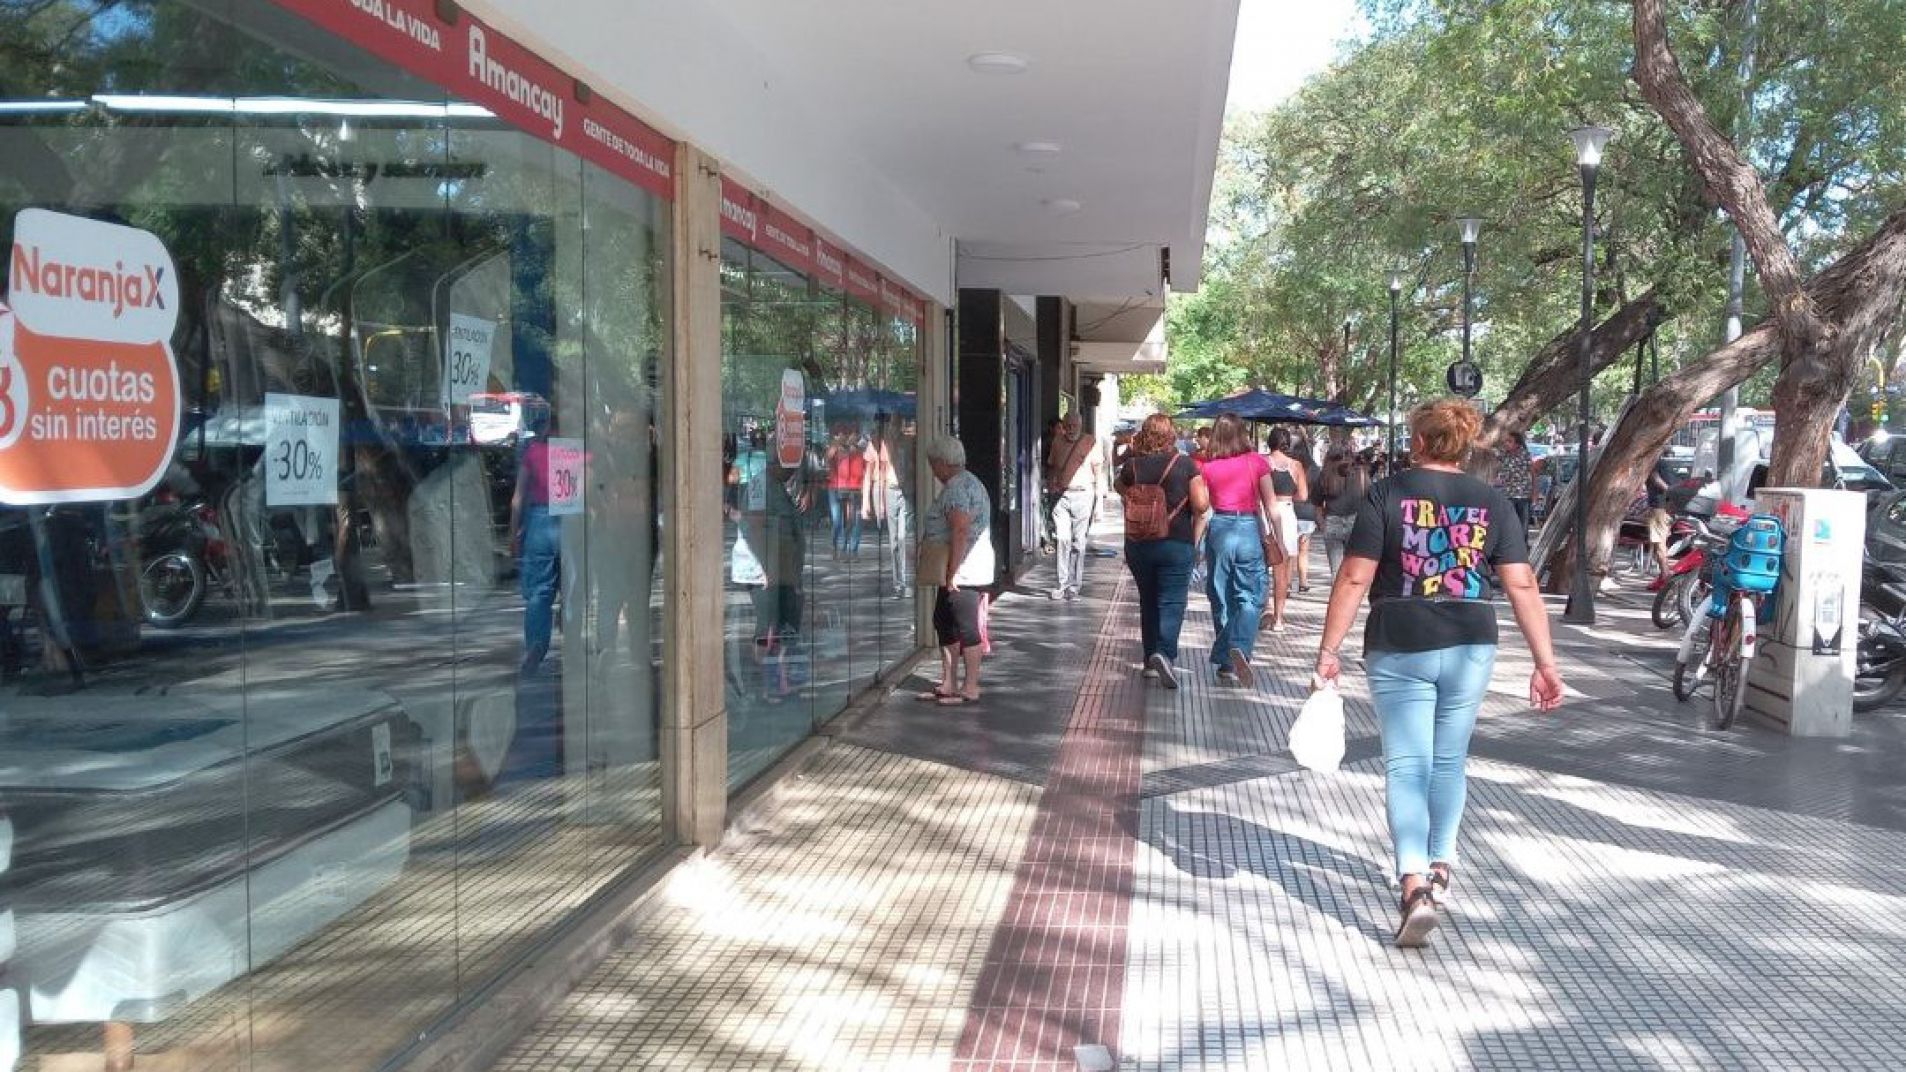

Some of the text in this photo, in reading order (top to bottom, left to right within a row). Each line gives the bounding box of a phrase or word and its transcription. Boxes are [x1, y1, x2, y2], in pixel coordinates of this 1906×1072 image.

[386, 3, 406, 33] LA
[407, 14, 440, 52] VIDA
[469, 24, 563, 140] Amancay
[583, 117, 613, 148] GENTE
[47, 360, 155, 403] cuotas
[30, 405, 156, 440] sin interés
[1400, 499, 1489, 528] TRAVEL
[1401, 524, 1487, 557] MORE
